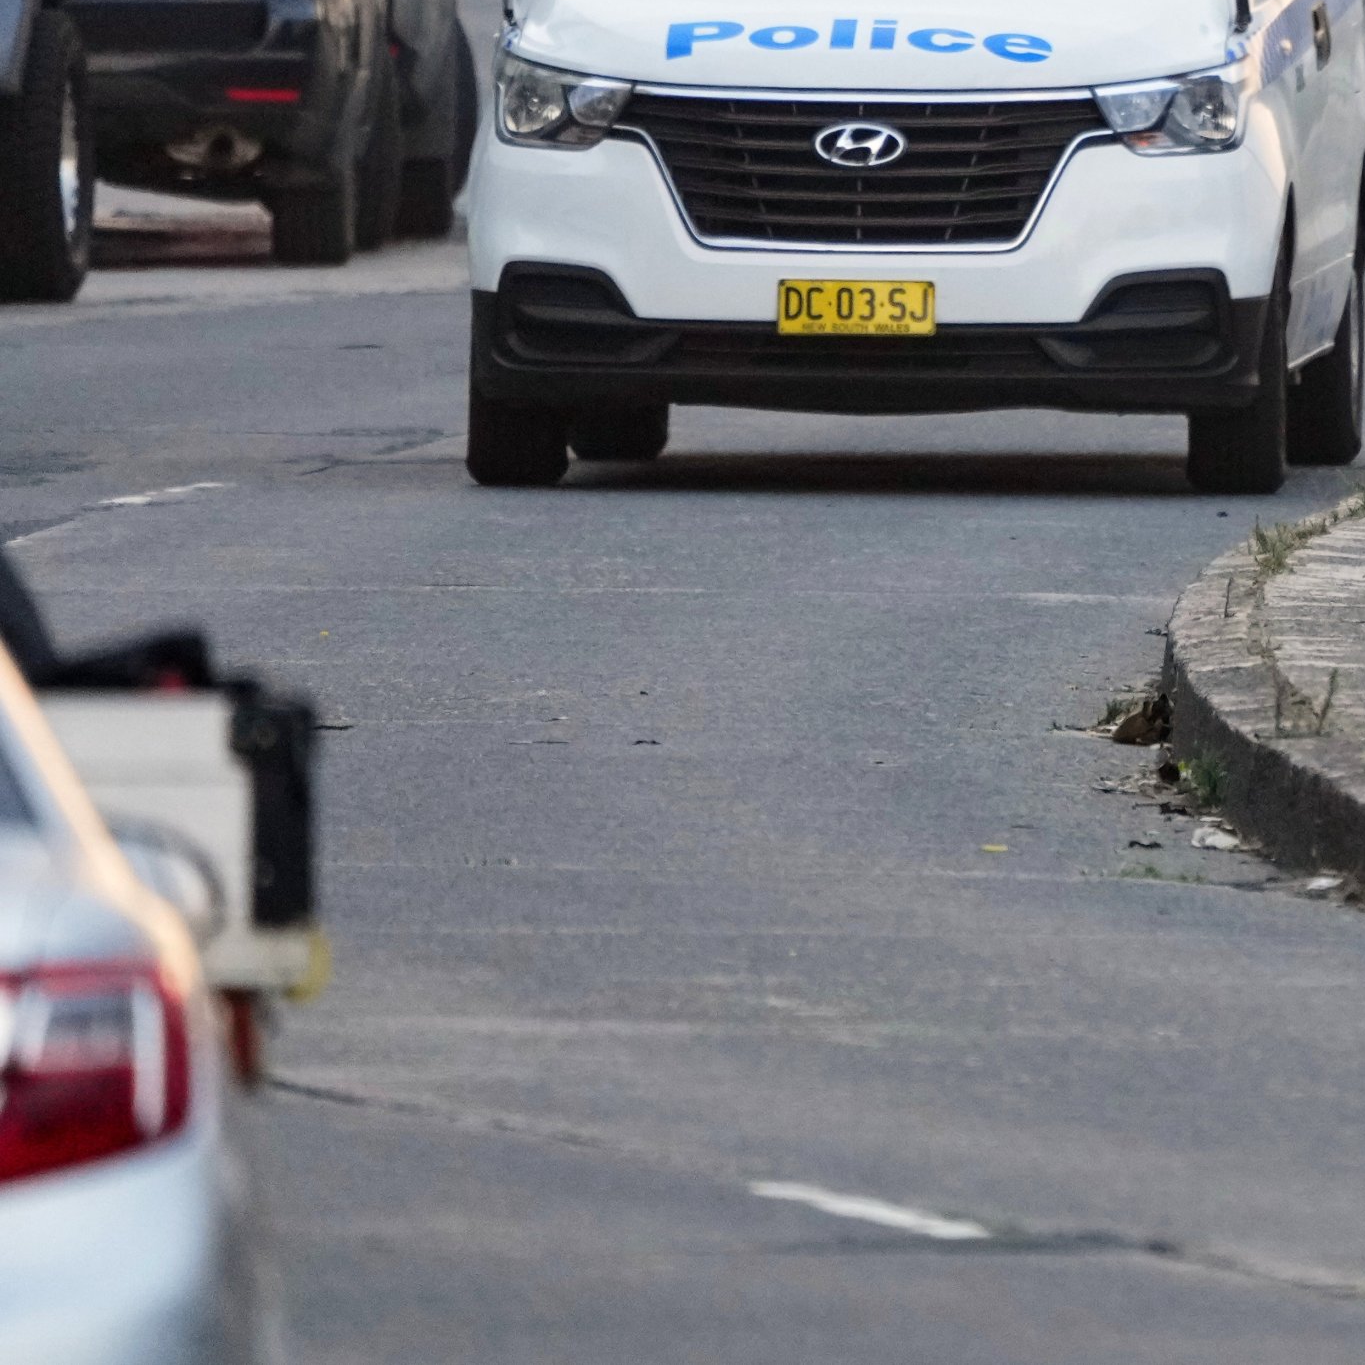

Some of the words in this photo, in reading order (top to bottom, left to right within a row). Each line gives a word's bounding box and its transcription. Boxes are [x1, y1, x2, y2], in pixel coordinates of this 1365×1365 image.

[666, 19, 1053, 63] Police
[802, 322, 826, 333] NEW
[832, 323, 868, 333] SOUTH
[873, 323, 911, 333] WALES
